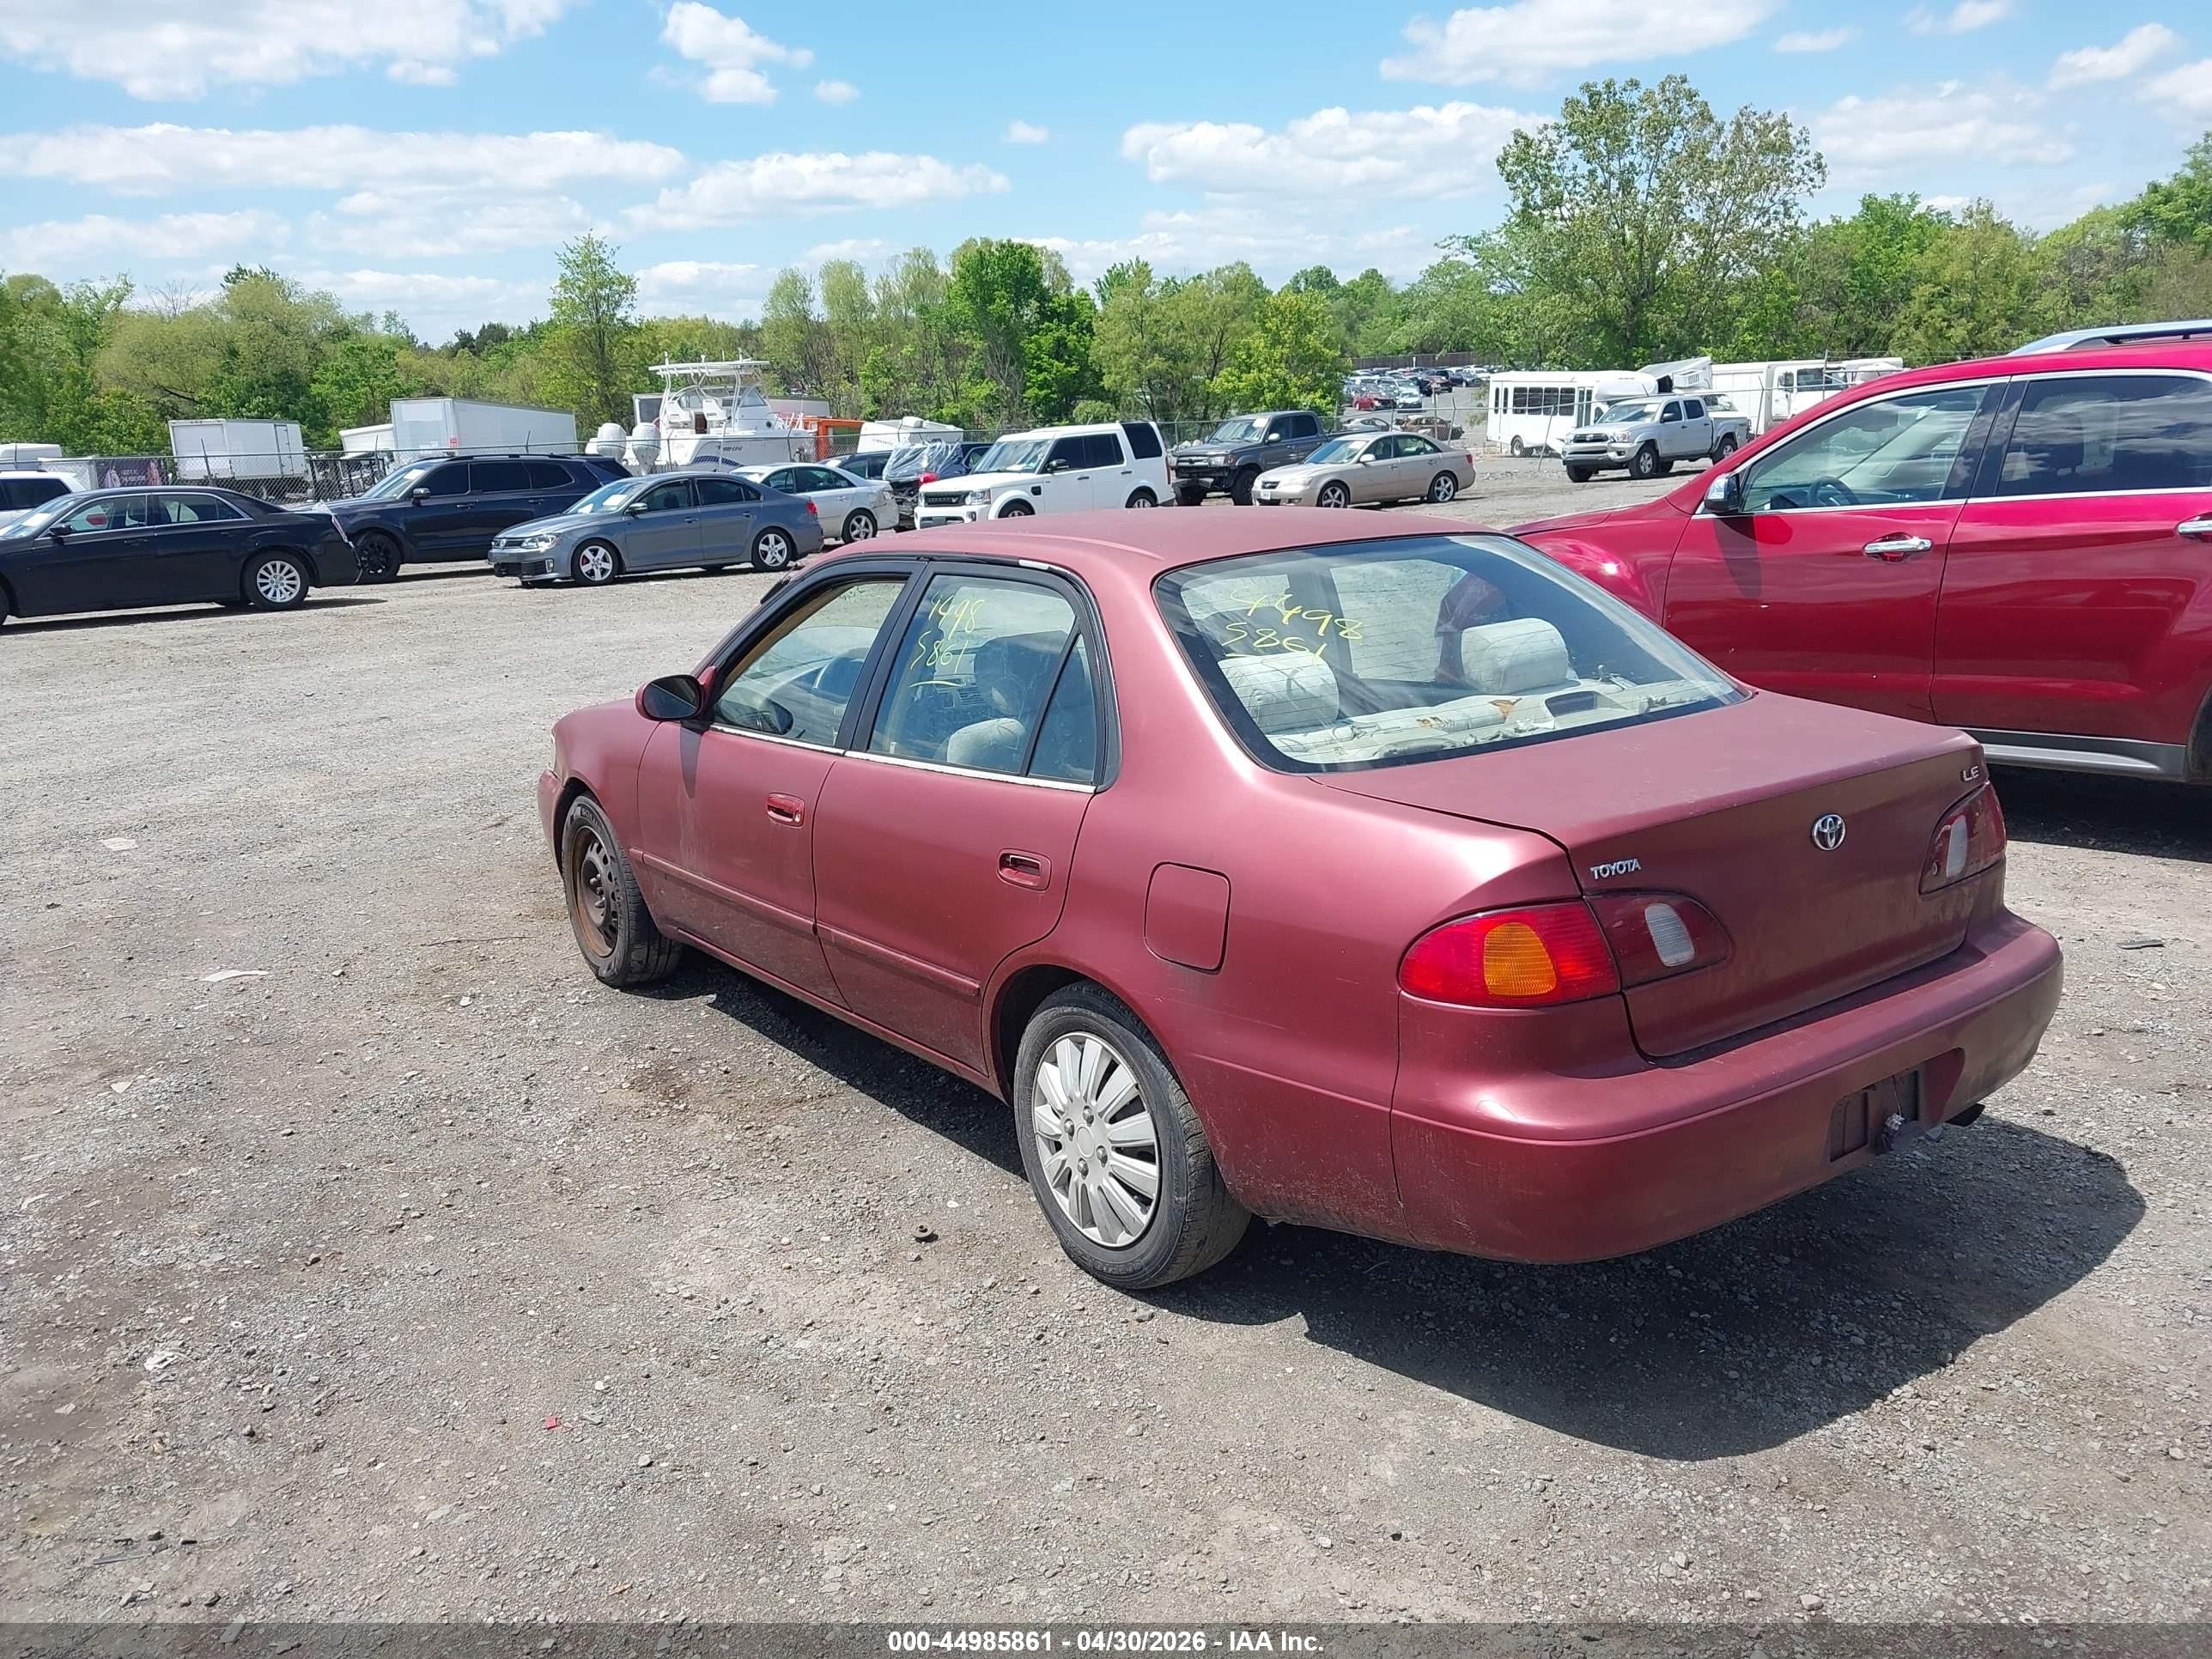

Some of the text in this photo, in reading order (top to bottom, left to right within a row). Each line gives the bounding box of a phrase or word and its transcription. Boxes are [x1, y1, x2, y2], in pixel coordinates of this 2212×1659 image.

[1230, 589, 1364, 640] 4498
[910, 630, 969, 674] 5861
[1222, 622, 1328, 667] 5861
[1962, 765, 1979, 781] LE
[1589, 858, 1642, 880] TOYOTA
